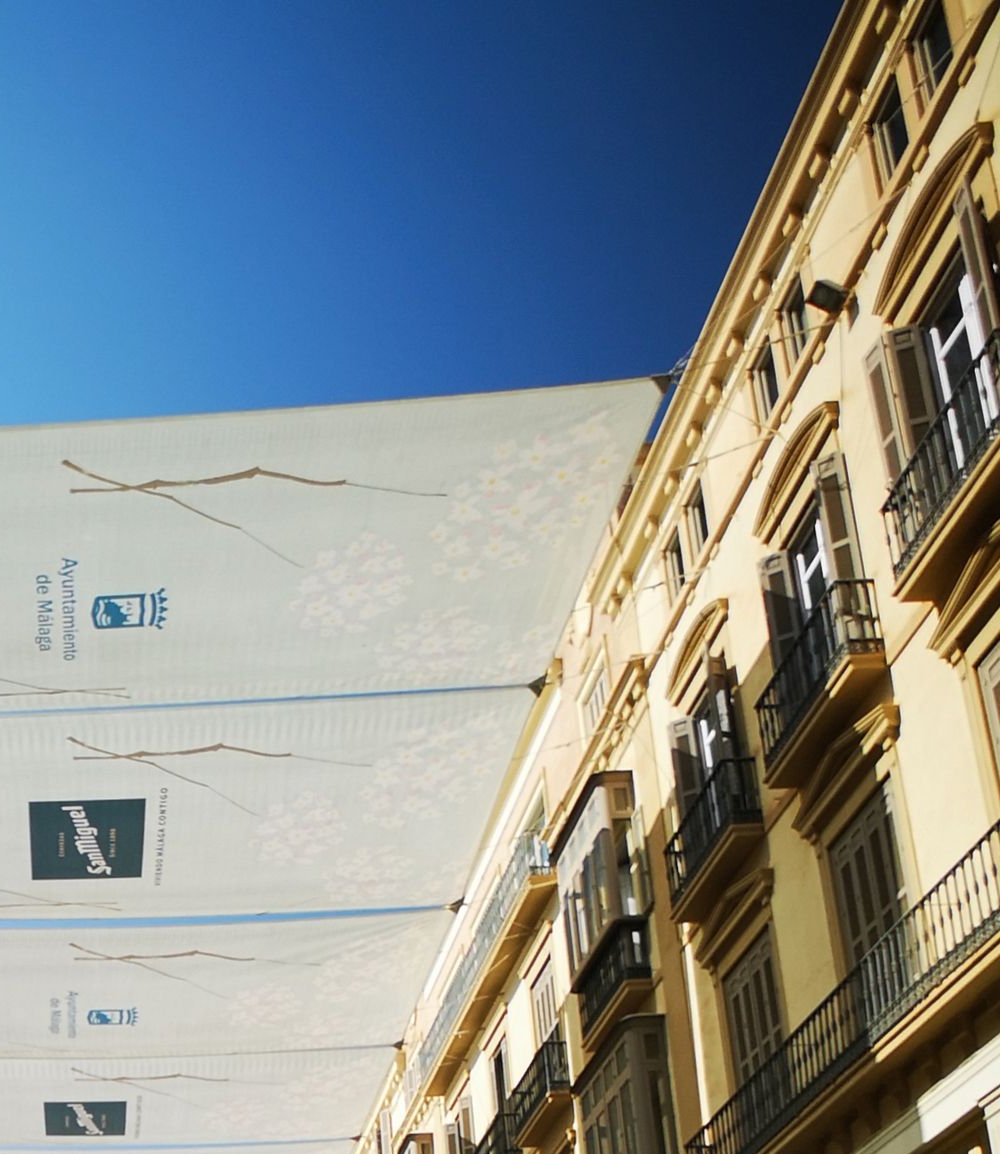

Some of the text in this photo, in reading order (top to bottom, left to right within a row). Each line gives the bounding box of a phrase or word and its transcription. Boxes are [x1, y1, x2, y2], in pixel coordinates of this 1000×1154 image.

[35, 574, 54, 652] de Málaga
[57, 557, 78, 661] Ayuntamiento
[158, 787, 169, 827] CONTIGO
